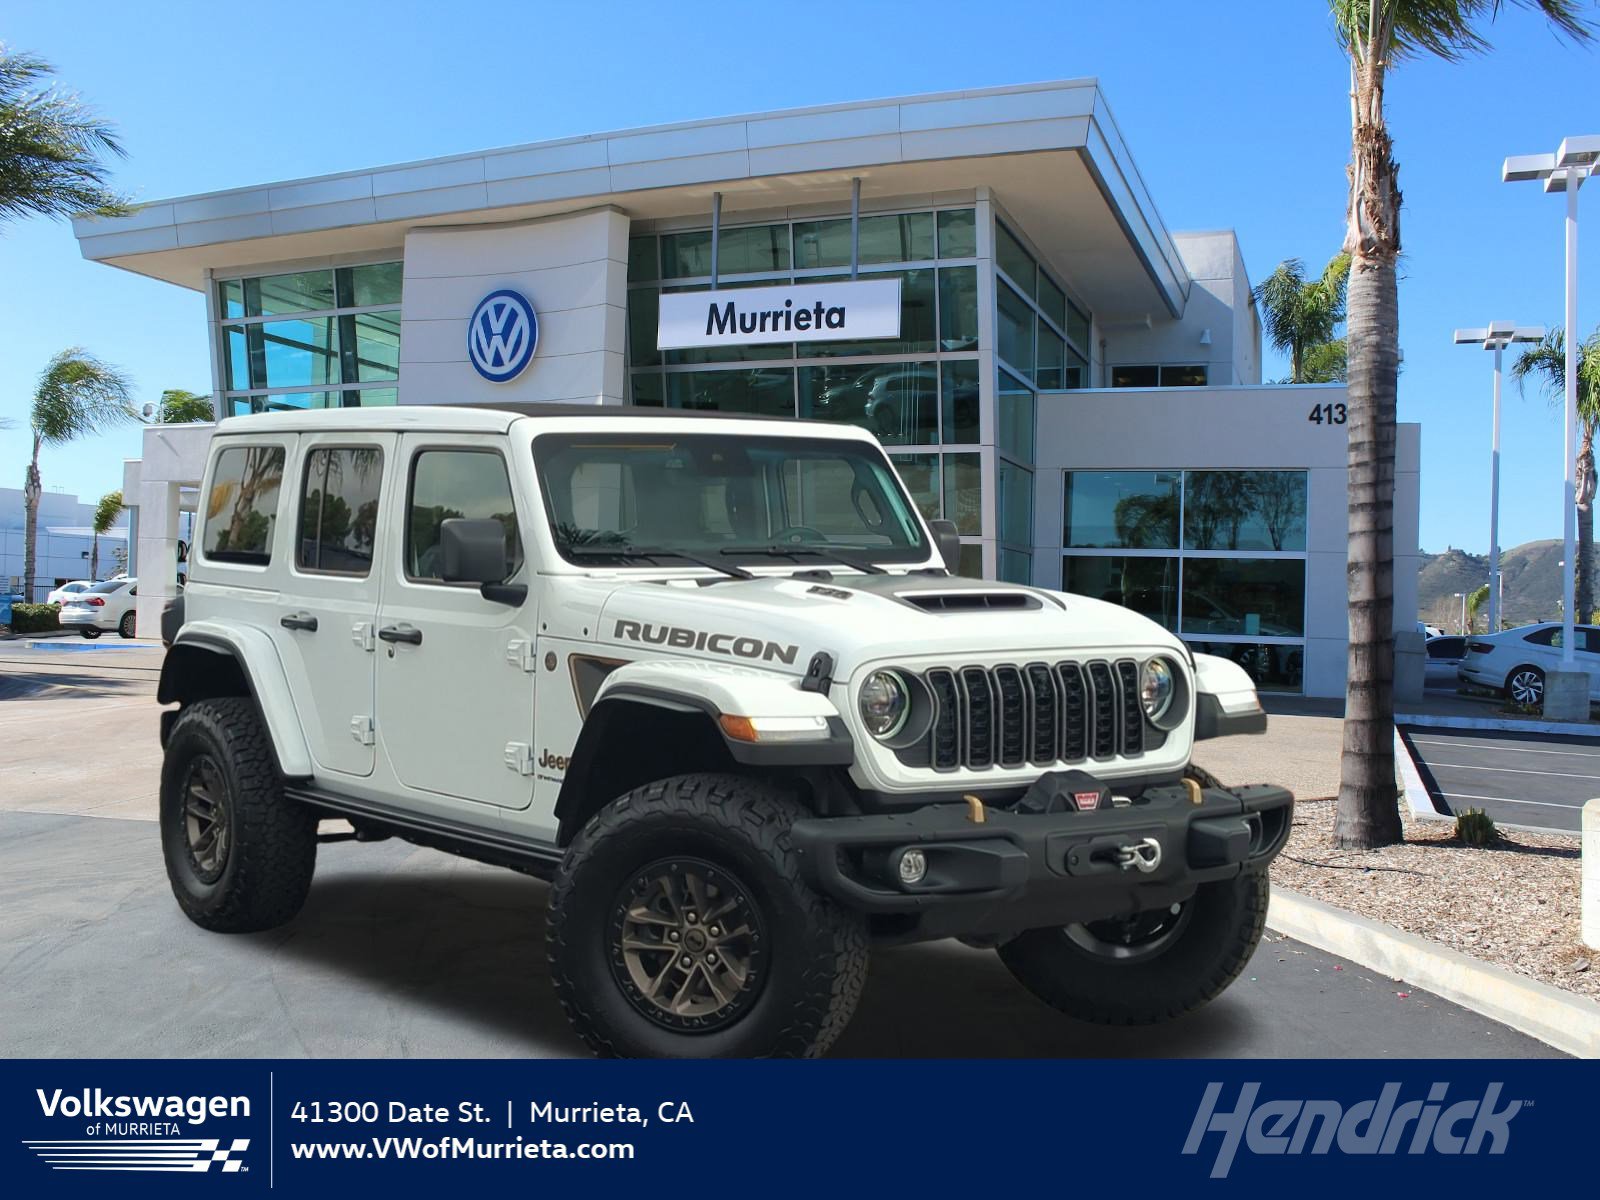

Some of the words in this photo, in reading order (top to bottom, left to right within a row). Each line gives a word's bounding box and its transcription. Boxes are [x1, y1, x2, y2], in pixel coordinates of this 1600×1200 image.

[705, 298, 847, 336] Murrieta
[1308, 403, 1347, 425] 413
[614, 619, 799, 665] RUBICON
